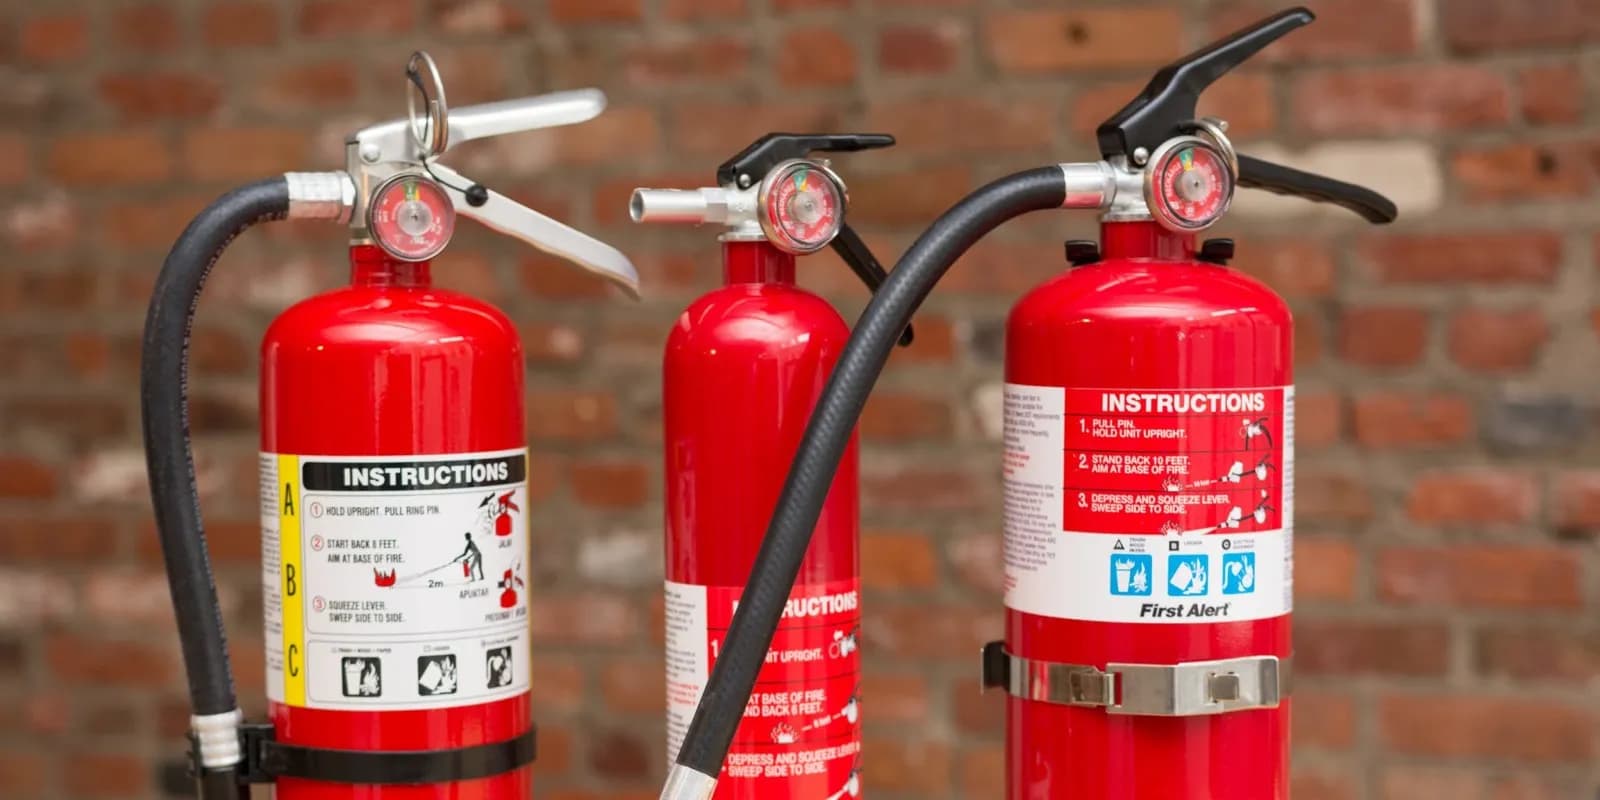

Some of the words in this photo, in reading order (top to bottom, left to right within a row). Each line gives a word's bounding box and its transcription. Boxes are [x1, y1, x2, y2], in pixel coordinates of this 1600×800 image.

[1101, 392, 1265, 413] INSTRUCTIONS
[1079, 418, 1089, 433] 1.
[1092, 419, 1115, 429] PULL
[1117, 419, 1135, 429] PIN.
[1092, 429, 1118, 438] HOLD
[1120, 429, 1141, 438] UNIT
[1143, 429, 1187, 439] UPRIGHT.
[1092, 454, 1124, 465] STAND
[1124, 455, 1150, 465] BACK
[1153, 456, 1163, 465] 10
[1165, 456, 1190, 466] FEET.
[343, 462, 508, 487] INSTRUCTIONS
[1092, 464, 1109, 473] AIM
[1110, 464, 1123, 473] AT
[1124, 465, 1149, 474] BASE
[1151, 465, 1165, 474] OF
[1166, 465, 1189, 475] FIRE.
[284, 482, 295, 516] A
[1091, 493, 1133, 504] DEPRESS
[1135, 494, 1156, 504] AND
[1158, 494, 1200, 505] SQUEEZE
[1201, 494, 1230, 505] LEVER.
[326, 506, 345, 516] HOLD
[384, 506, 404, 516] PULL
[406, 505, 425, 516] RING
[1091, 504, 1124, 513] SWEEP
[1125, 504, 1146, 513] SIDE
[1147, 504, 1162, 514] TO
[1163, 504, 1187, 514] SIDE.
[327, 539, 349, 549] START
[351, 539, 370, 549] BACK
[327, 553, 340, 563] AIM
[342, 553, 351, 563] AT
[353, 553, 372, 563] BASE
[373, 553, 385, 563] OF
[286, 563, 296, 596] B
[427, 579, 444, 589] 2m
[329, 600, 360, 611] SQUEEZE
[732, 590, 857, 619] IRUCTIONS
[1139, 603, 1184, 618] First
[1186, 602, 1230, 618] Alert
[329, 612, 353, 623] SWEEP
[355, 612, 371, 623] SIDE
[374, 612, 384, 623] TO
[288, 644, 299, 677] C
[780, 647, 823, 664] UPRIGHT.
[762, 692, 788, 705] BASE
[790, 691, 803, 704] OF
[762, 705, 789, 717] BACK
[799, 702, 824, 715] FEET.
[728, 752, 774, 766] DEPRESS
[775, 751, 797, 765] AND
[798, 747, 838, 763] SQUEEZE
[728, 765, 763, 778] SWEEP
[765, 764, 788, 777] SIDE
[789, 764, 803, 776] TO
